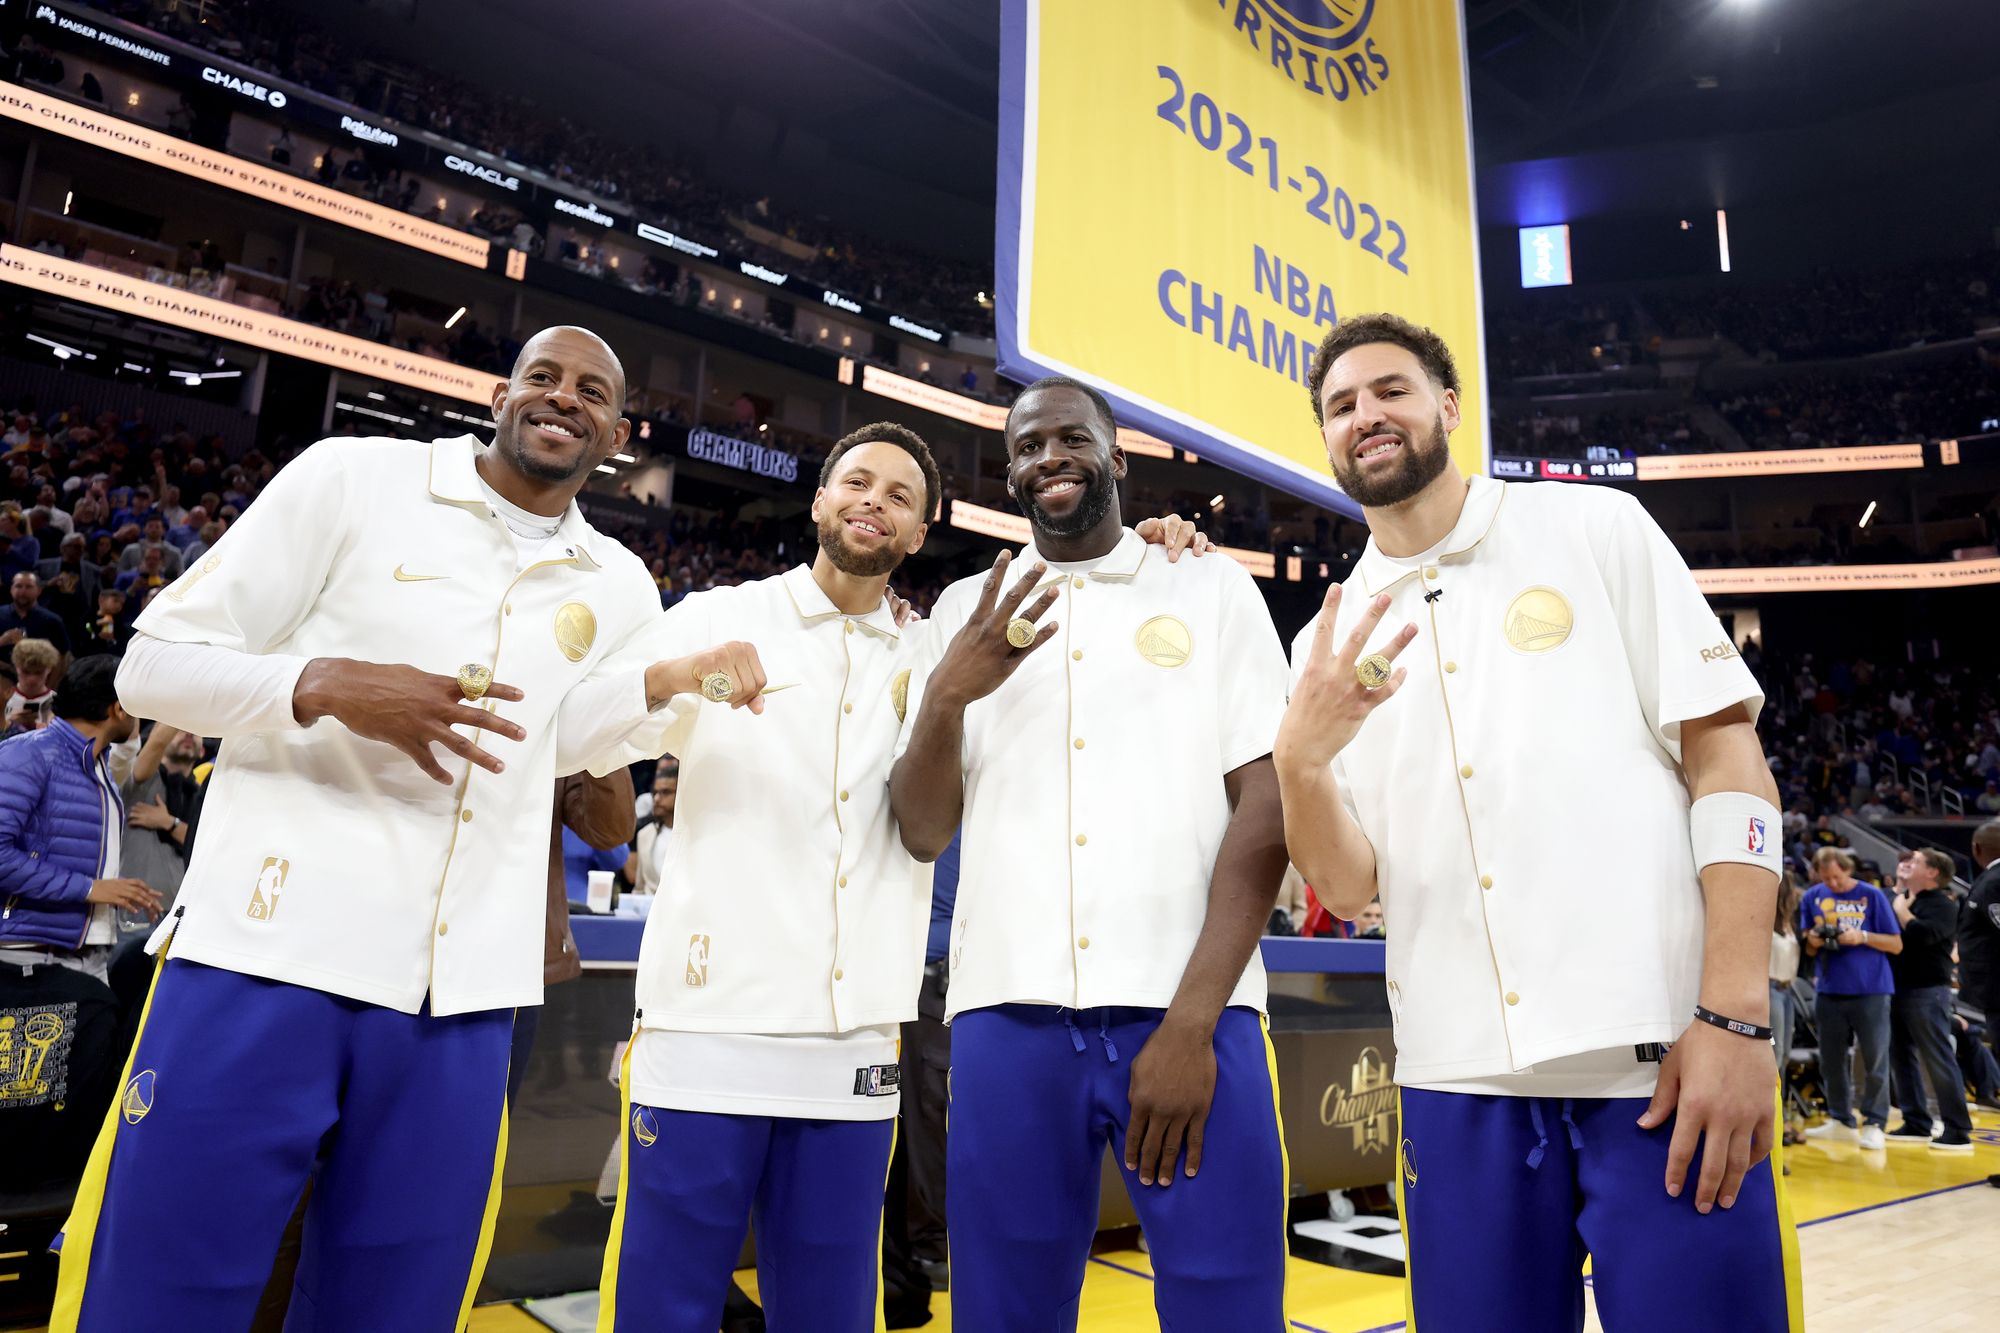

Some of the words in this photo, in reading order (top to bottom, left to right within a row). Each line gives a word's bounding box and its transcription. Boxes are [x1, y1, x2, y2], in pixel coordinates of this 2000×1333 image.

[58, 17, 97, 40] KAISER
[98, 32, 171, 67] PERMANENTE
[201, 66, 269, 102] CHASE
[340, 115, 399, 148] Rakuten
[40, 107, 152, 150] CHAMPIONS
[165, 148, 235, 176] GOLDEN
[239, 172, 288, 194] STATE
[292, 187, 375, 223] WARRIORS
[410, 226, 490, 258] CHAMPION
[443, 155, 520, 192] ORACLE
[1156, 65, 1409, 276] 2021-2022
[1253, 243, 1338, 328] NBA
[38, 266, 91, 287] 2022
[97, 283, 138, 301] NBA
[143, 295, 254, 331] CHAMPIONS
[267, 327, 337, 353] GOLDEN
[340, 347, 390, 367] STATE
[393, 361, 475, 389] WARRIORS
[1157, 268, 1317, 389] CHAMP
[687, 428, 798, 483] CHAMPIONS
[249, 902, 264, 916] 75
[0, 1001, 78, 1017] HAMPIONS
